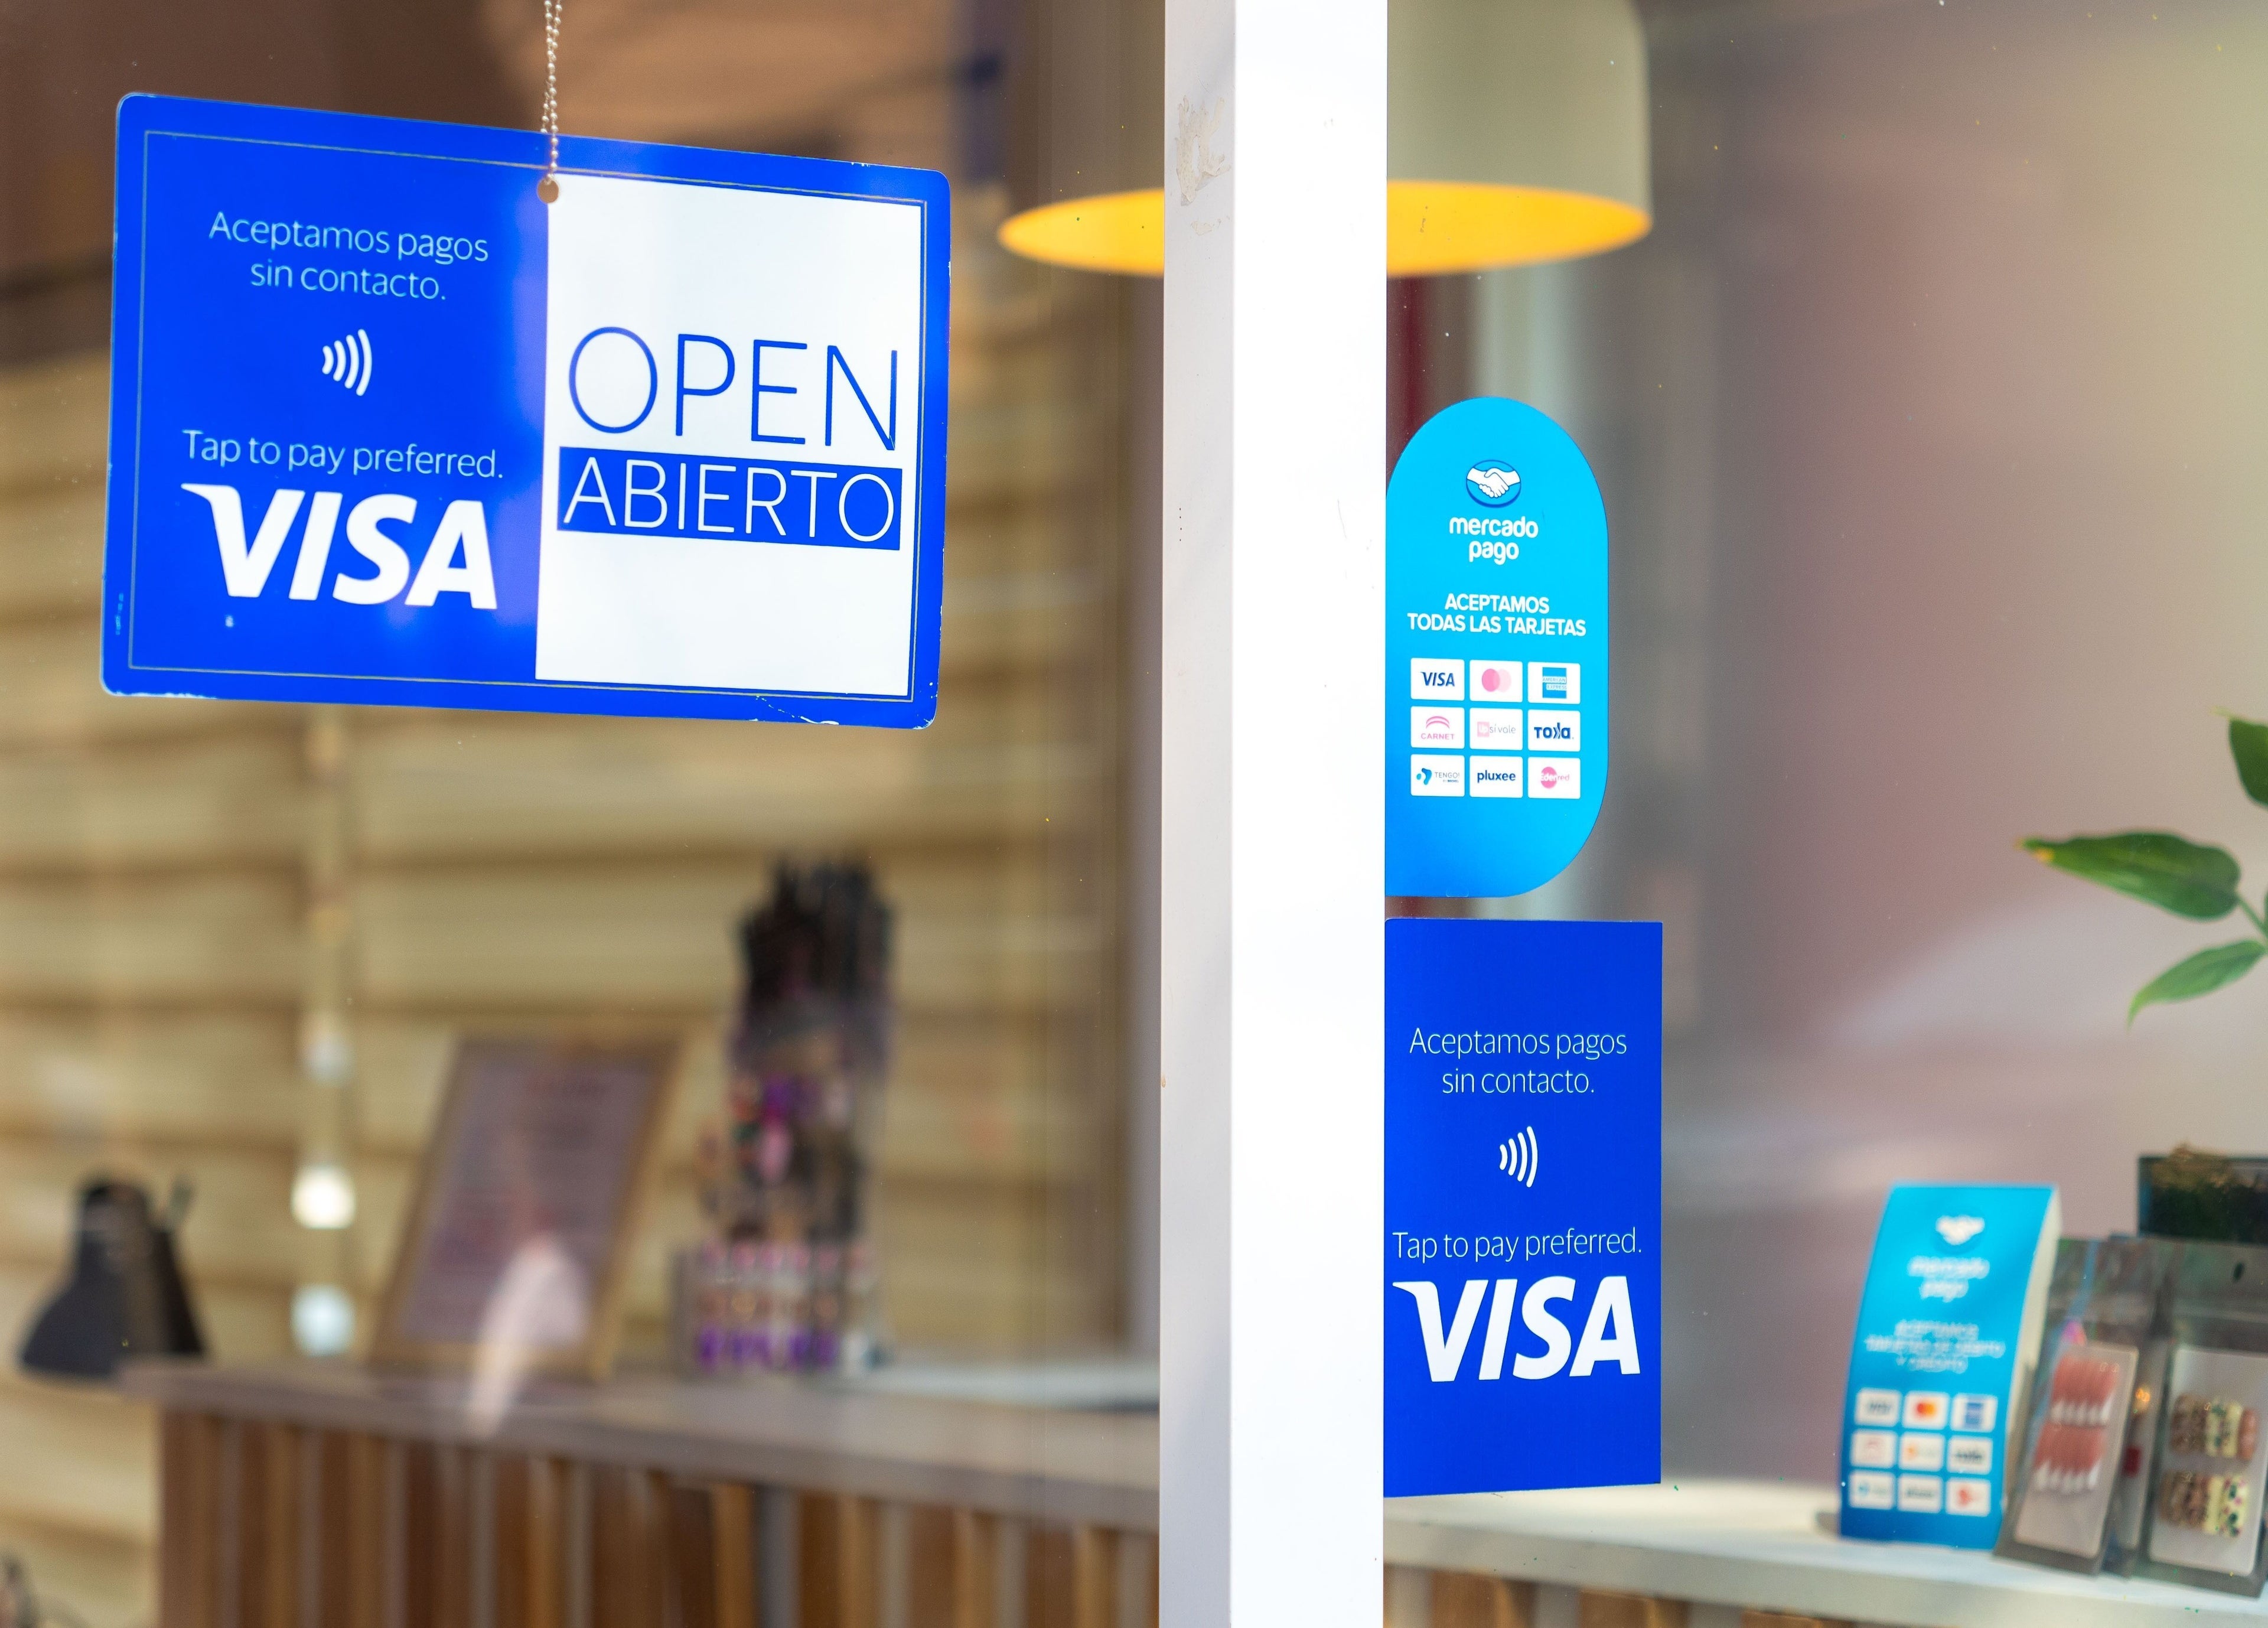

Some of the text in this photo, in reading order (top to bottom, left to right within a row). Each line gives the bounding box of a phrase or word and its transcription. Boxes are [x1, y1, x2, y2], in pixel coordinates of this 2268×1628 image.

[209, 211, 488, 265] Aceptamos pagos
[251, 261, 447, 300] sin contacto.
[568, 326, 898, 451] OPEN
[183, 429, 504, 479] Tap to pay preferred.
[563, 457, 895, 543] ABIERTO
[1449, 516, 1539, 538] mercado
[181, 483, 497, 610] VISA
[1468, 541, 1520, 565] pago
[1445, 593, 1550, 614] ACEPTAMOS
[1407, 613, 1587, 637] TODAS LAS TARJETAS
[1420, 671, 1455, 687] VISA
[1477, 769, 1516, 783] pluxee
[1409, 1027, 1627, 1060] Aceptamos pagos
[1442, 1068, 1595, 1094] sin contacto.
[1392, 1227, 1643, 1264] Tap to pay preferred.
[1392, 1275, 1641, 1382] VISA
